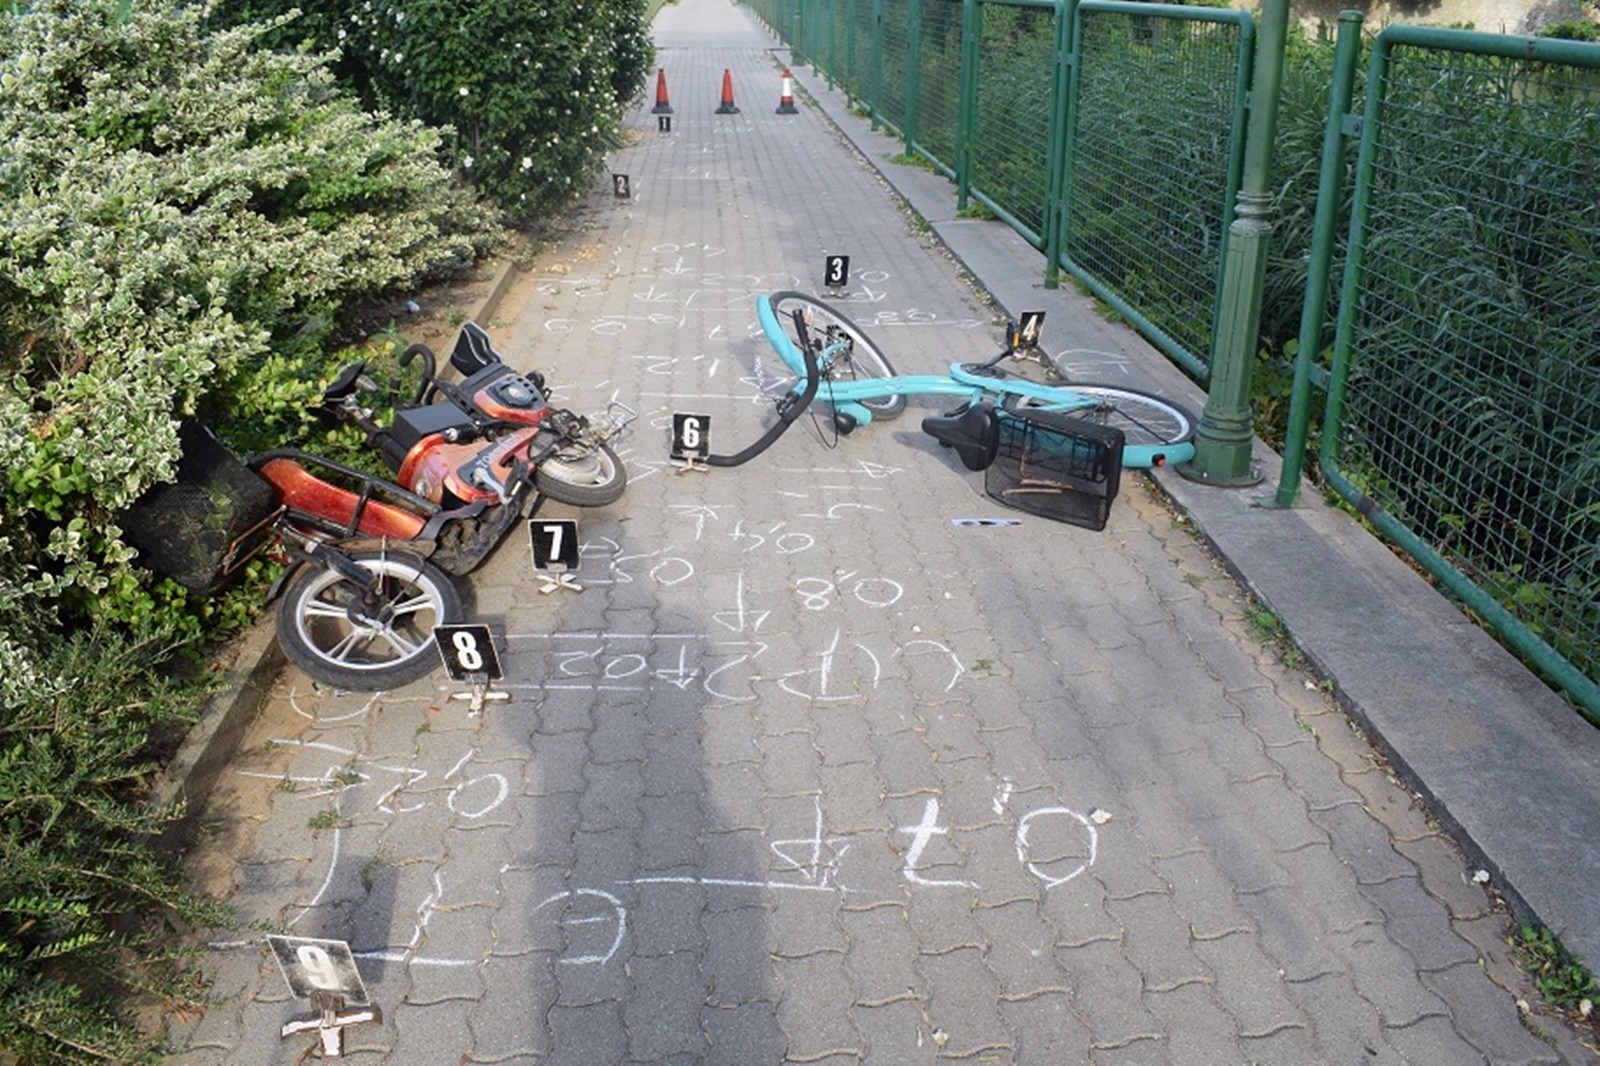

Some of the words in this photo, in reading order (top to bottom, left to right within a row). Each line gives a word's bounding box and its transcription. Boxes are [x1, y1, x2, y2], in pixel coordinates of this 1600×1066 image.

[661, 117, 667, 130] 1
[617, 176, 627, 194] 2
[831, 257, 843, 281] 3
[1022, 314, 1039, 341] 4
[682, 417, 701, 448] 6
[543, 525, 563, 560] 7
[452, 631, 483, 670] 8
[296, 945, 339, 990] 9
